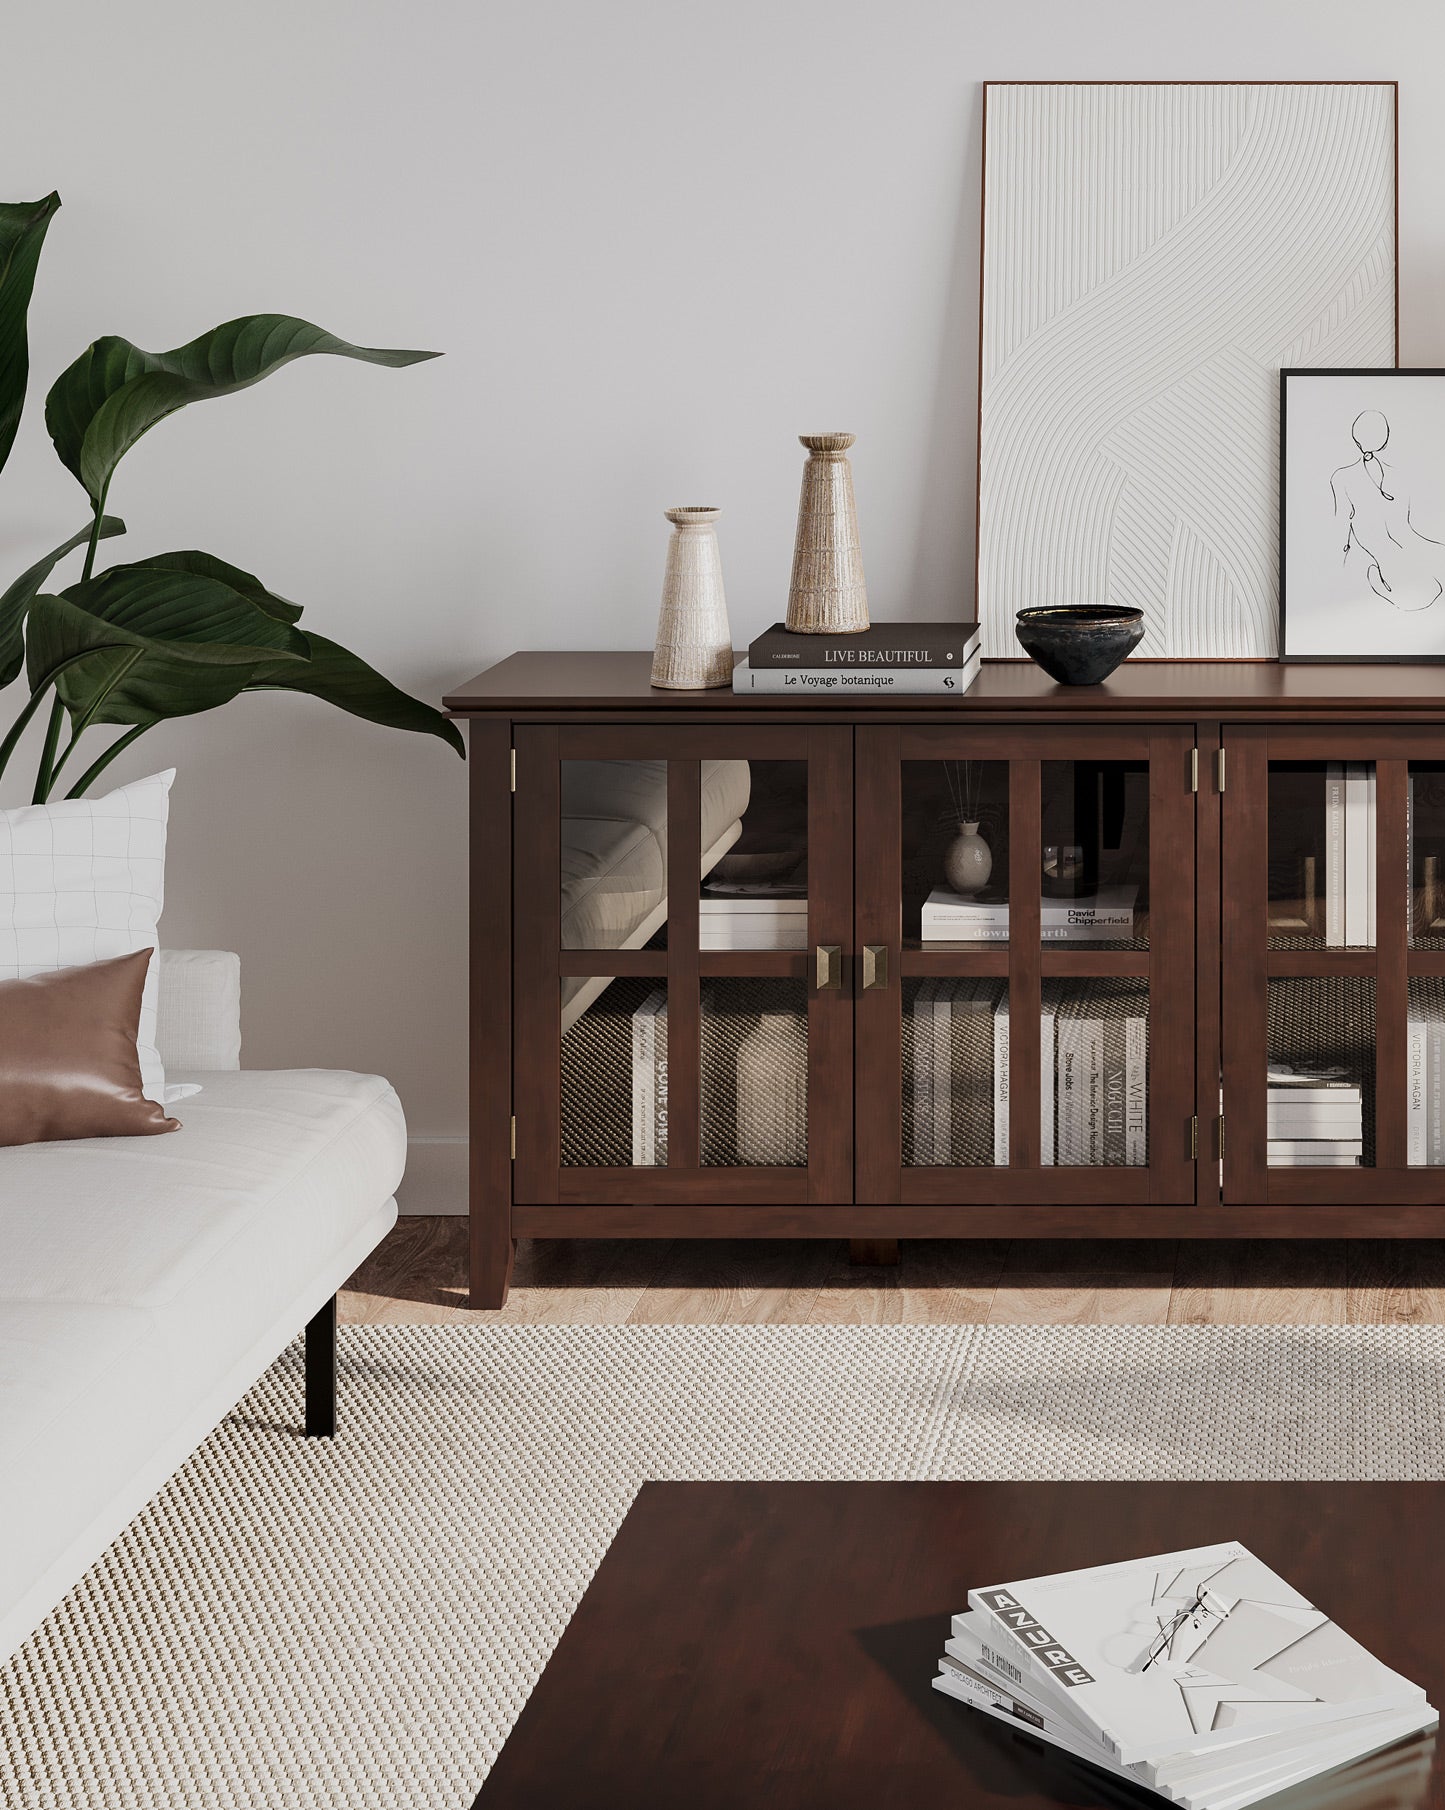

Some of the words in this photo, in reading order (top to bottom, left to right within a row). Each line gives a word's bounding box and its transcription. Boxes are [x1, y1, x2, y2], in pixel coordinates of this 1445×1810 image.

[825, 650, 855, 662] LIVE
[858, 650, 933, 662] BEAUTIFUL
[784, 674, 797, 685] Le
[800, 674, 838, 688] Voyage
[841, 674, 894, 688] botanique
[1331, 786, 1339, 808] FRIDA
[1068, 909, 1096, 917] David
[1068, 917, 1129, 926] Chipperfield
[974, 928, 1009, 937] down
[1041, 928, 1068, 937] arth
[999, 1026, 1008, 1068] VICTORIA
[1412, 1033, 1421, 1076] VICTORIA
[1065, 1052, 1074, 1072] Steve
[658, 1061, 668, 1104] GONE
[999, 1070, 1008, 1102] HAGAN
[1065, 1073, 1074, 1090] Jobs
[1090, 1073, 1098, 1084] The
[1108, 1070, 1122, 1134] NOGUCHI
[1412, 1078, 1421, 1110] HAGAN
[1129, 1082, 1143, 1132] WHITE
[658, 1110, 668, 1144] GIRL
[1088, 1108, 1098, 1129] Design
[994, 1594, 1091, 1685] AZURE
[974, 1682, 1002, 1704] ARCHITECT
